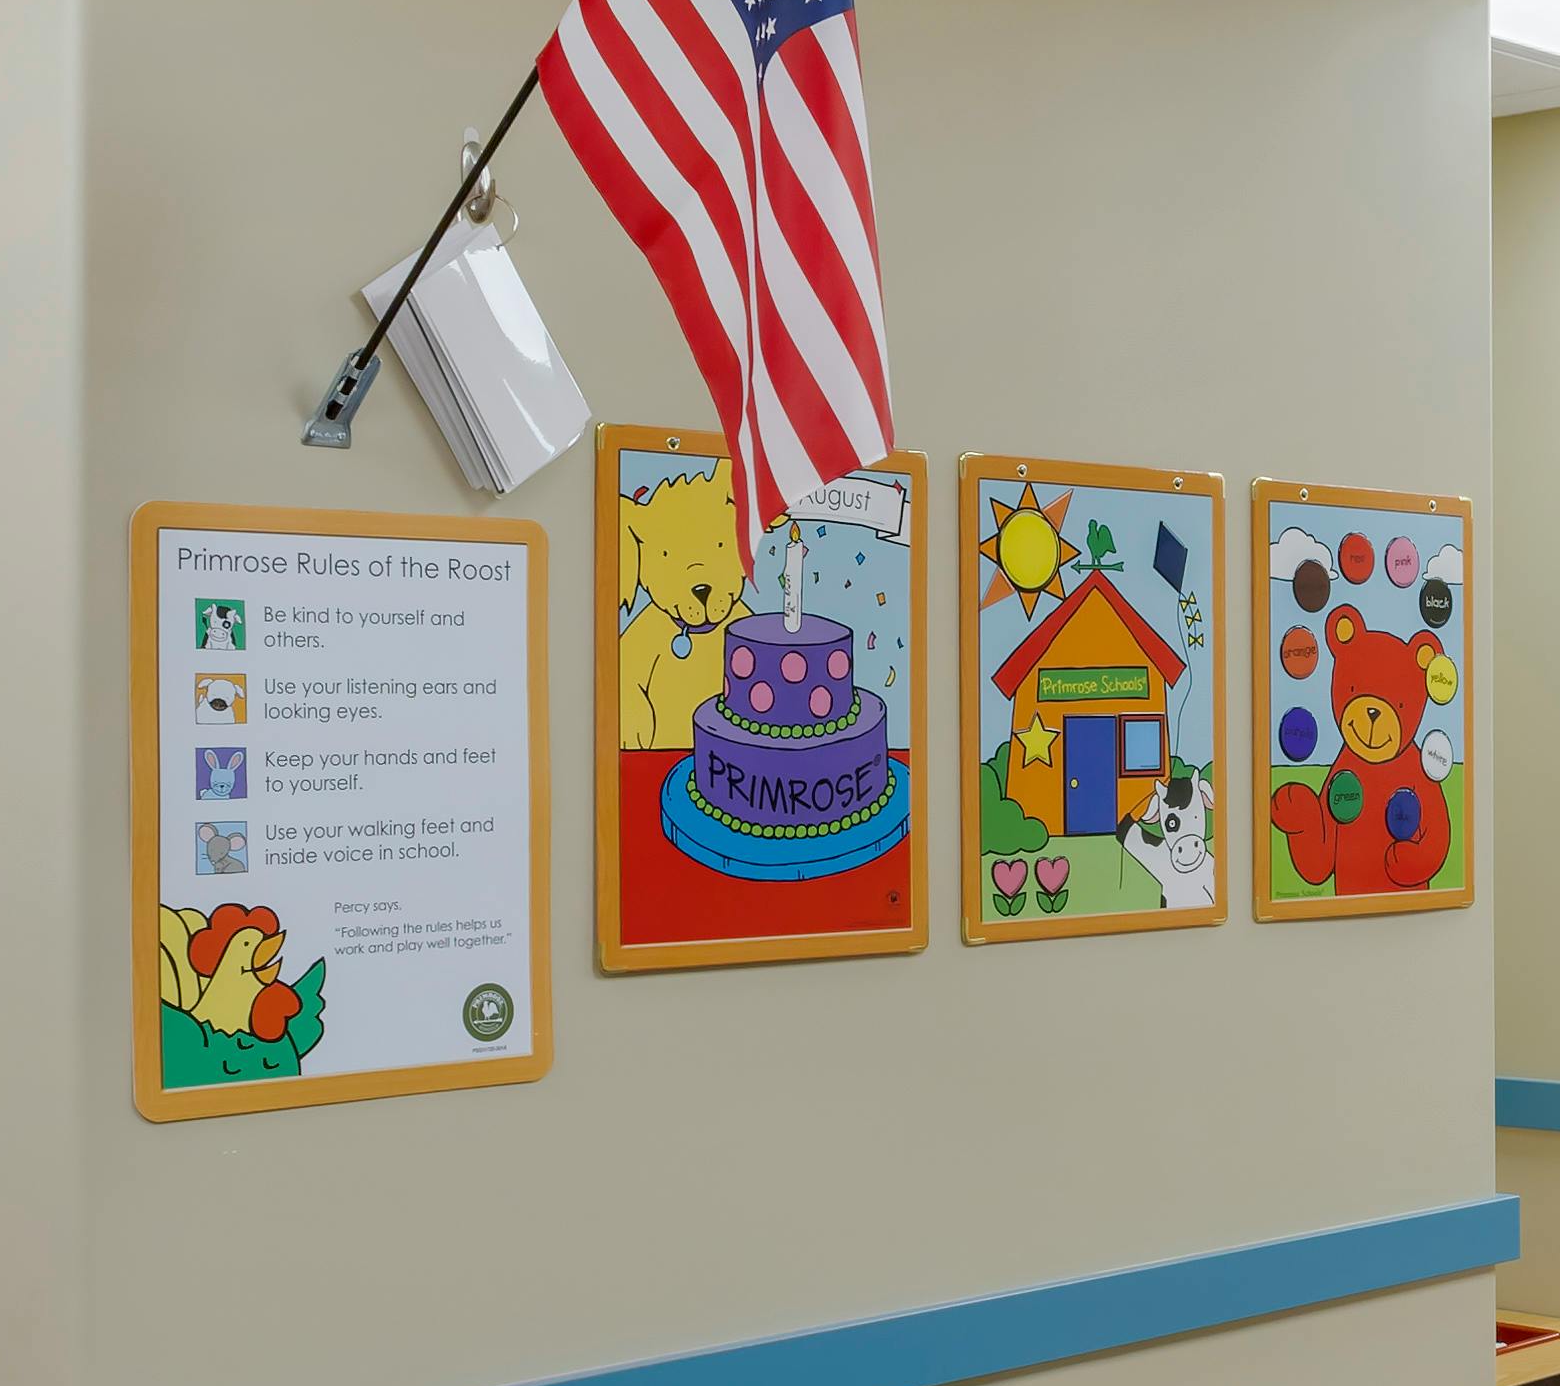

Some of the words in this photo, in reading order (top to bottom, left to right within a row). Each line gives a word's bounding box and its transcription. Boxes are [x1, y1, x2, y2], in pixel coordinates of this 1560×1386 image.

[178, 547, 288, 575] Primrose
[297, 552, 360, 577] Rules
[368, 555, 393, 578] of
[400, 556, 439, 579] the
[448, 558, 511, 581] Roost
[1425, 595, 1450, 609] black
[264, 606, 287, 623] Be
[292, 606, 330, 624] kind
[336, 609, 353, 625] to
[359, 609, 425, 628] yourself
[430, 610, 465, 627] and
[263, 631, 325, 649] others.
[263, 678, 296, 695] Use
[302, 680, 342, 701] your
[345, 678, 418, 699] listening
[422, 679, 458, 695] ears
[463, 679, 497, 695] and
[1040, 676, 1098, 695] Primrose
[263, 702, 331, 723] looking
[336, 703, 383, 722] eyes.
[264, 750, 314, 771] Keep
[319, 751, 361, 770] your
[363, 749, 419, 766] hands
[422, 748, 458, 765] and
[462, 747, 497, 764] feet
[265, 775, 284, 793] to
[288, 773, 364, 795] yourself.
[1332, 791, 1361, 805] green
[265, 824, 298, 841] Use
[302, 823, 343, 843] your
[347, 819, 417, 839] walking
[420, 817, 456, 834] feet
[459, 816, 495, 833] and
[264, 848, 318, 865] inside
[323, 845, 374, 863] voice
[378, 844, 394, 861] in
[398, 841, 460, 859] school.
[334, 901, 371, 915] Percy
[403, 922, 423, 936] the
[425, 920, 454, 934] rules
[455, 919, 488, 934] helps
[490, 919, 502, 930] us
[334, 942, 366, 956] work
[368, 940, 395, 954] and
[396, 939, 424, 955] play
[426, 937, 451, 950] well
